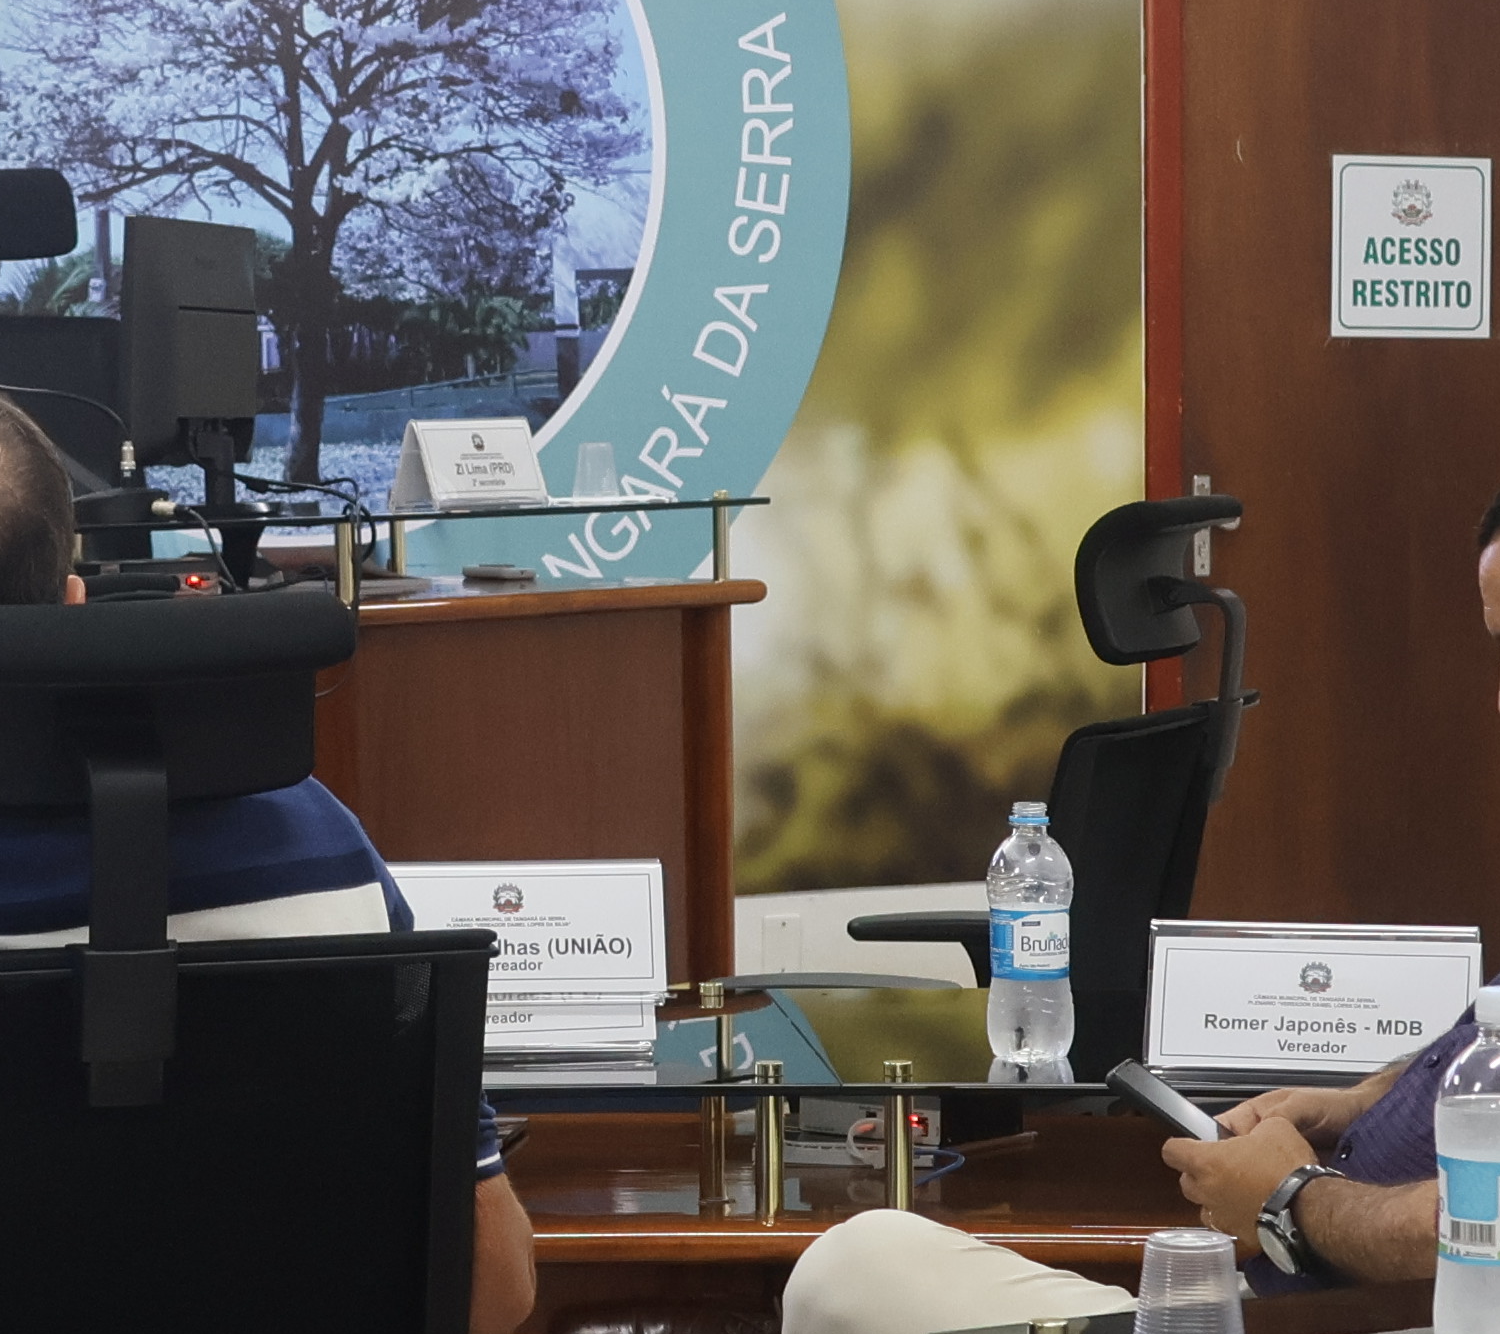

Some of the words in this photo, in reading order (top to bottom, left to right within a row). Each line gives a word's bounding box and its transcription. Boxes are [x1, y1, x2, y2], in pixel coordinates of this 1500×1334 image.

[728, 11, 794, 263] SERRA
[1364, 237, 1461, 266] ACESSO
[1352, 279, 1471, 308] RESTRITO
[692, 283, 769, 377] DA
[547, 934, 632, 959] (UNIÃO)
[1204, 1013, 1268, 1031] Romer
[1273, 1015, 1357, 1038] Japonês
[1376, 1019, 1423, 1036] MDB
[1277, 1038, 1348, 1055] Vereador
